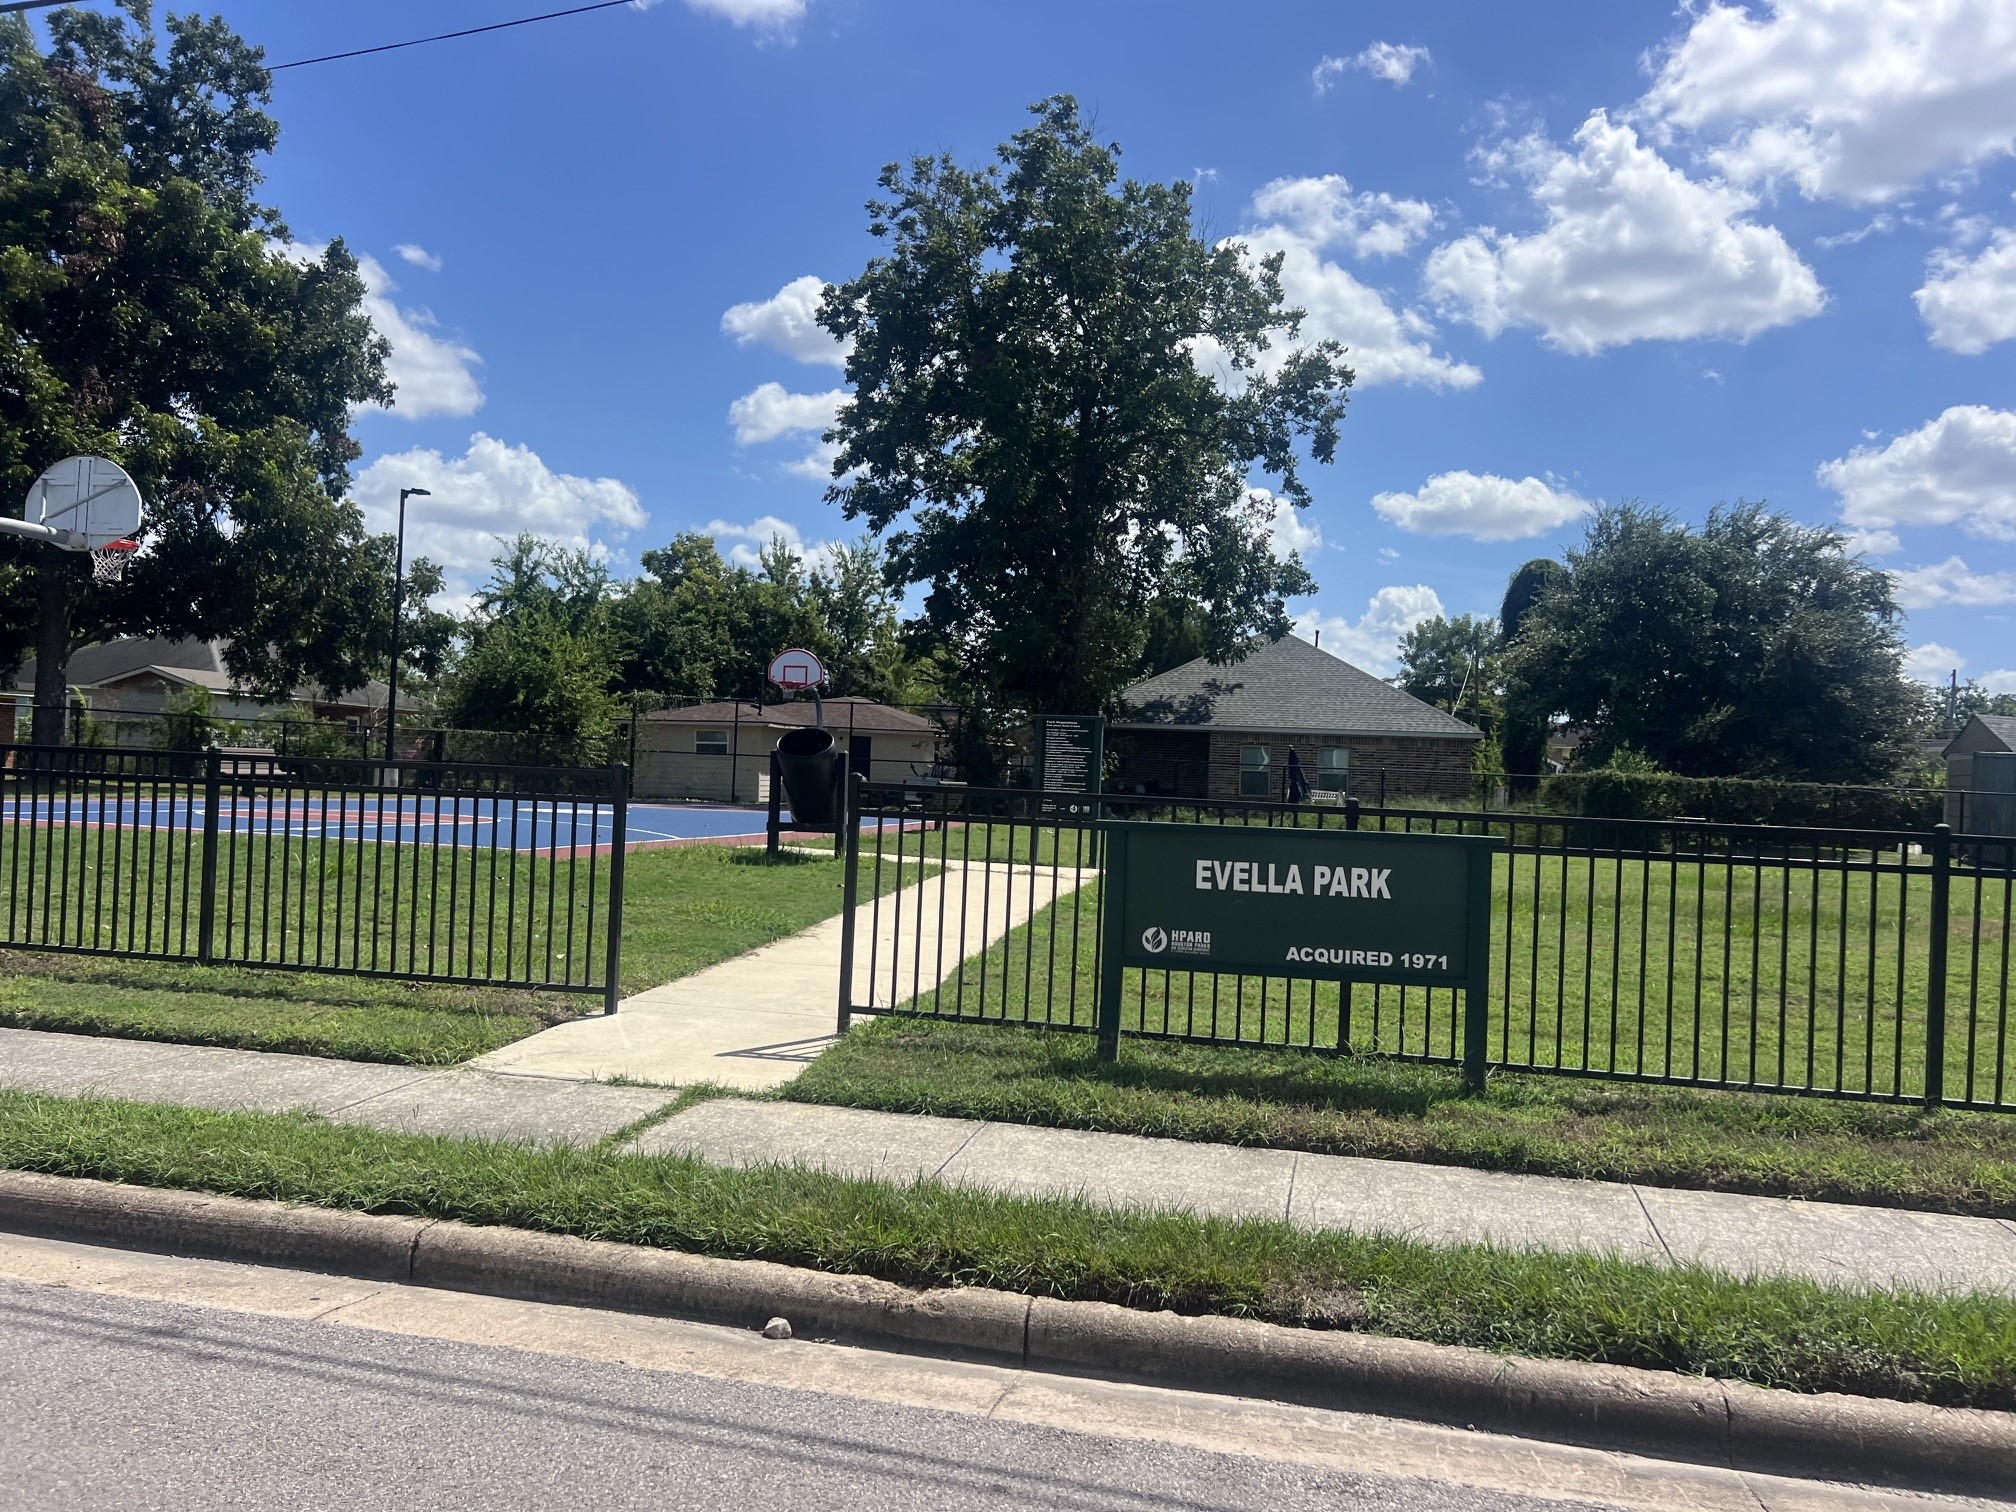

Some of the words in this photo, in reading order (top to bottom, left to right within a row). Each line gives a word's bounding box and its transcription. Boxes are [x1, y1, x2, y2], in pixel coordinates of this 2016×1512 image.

[1195, 860, 1304, 895] EVELLA
[1313, 865, 1392, 900] PARK
[1171, 930, 1211, 943] HPARD
[1286, 946, 1394, 967] ACQUIRED
[1400, 953, 1448, 970] 1971
